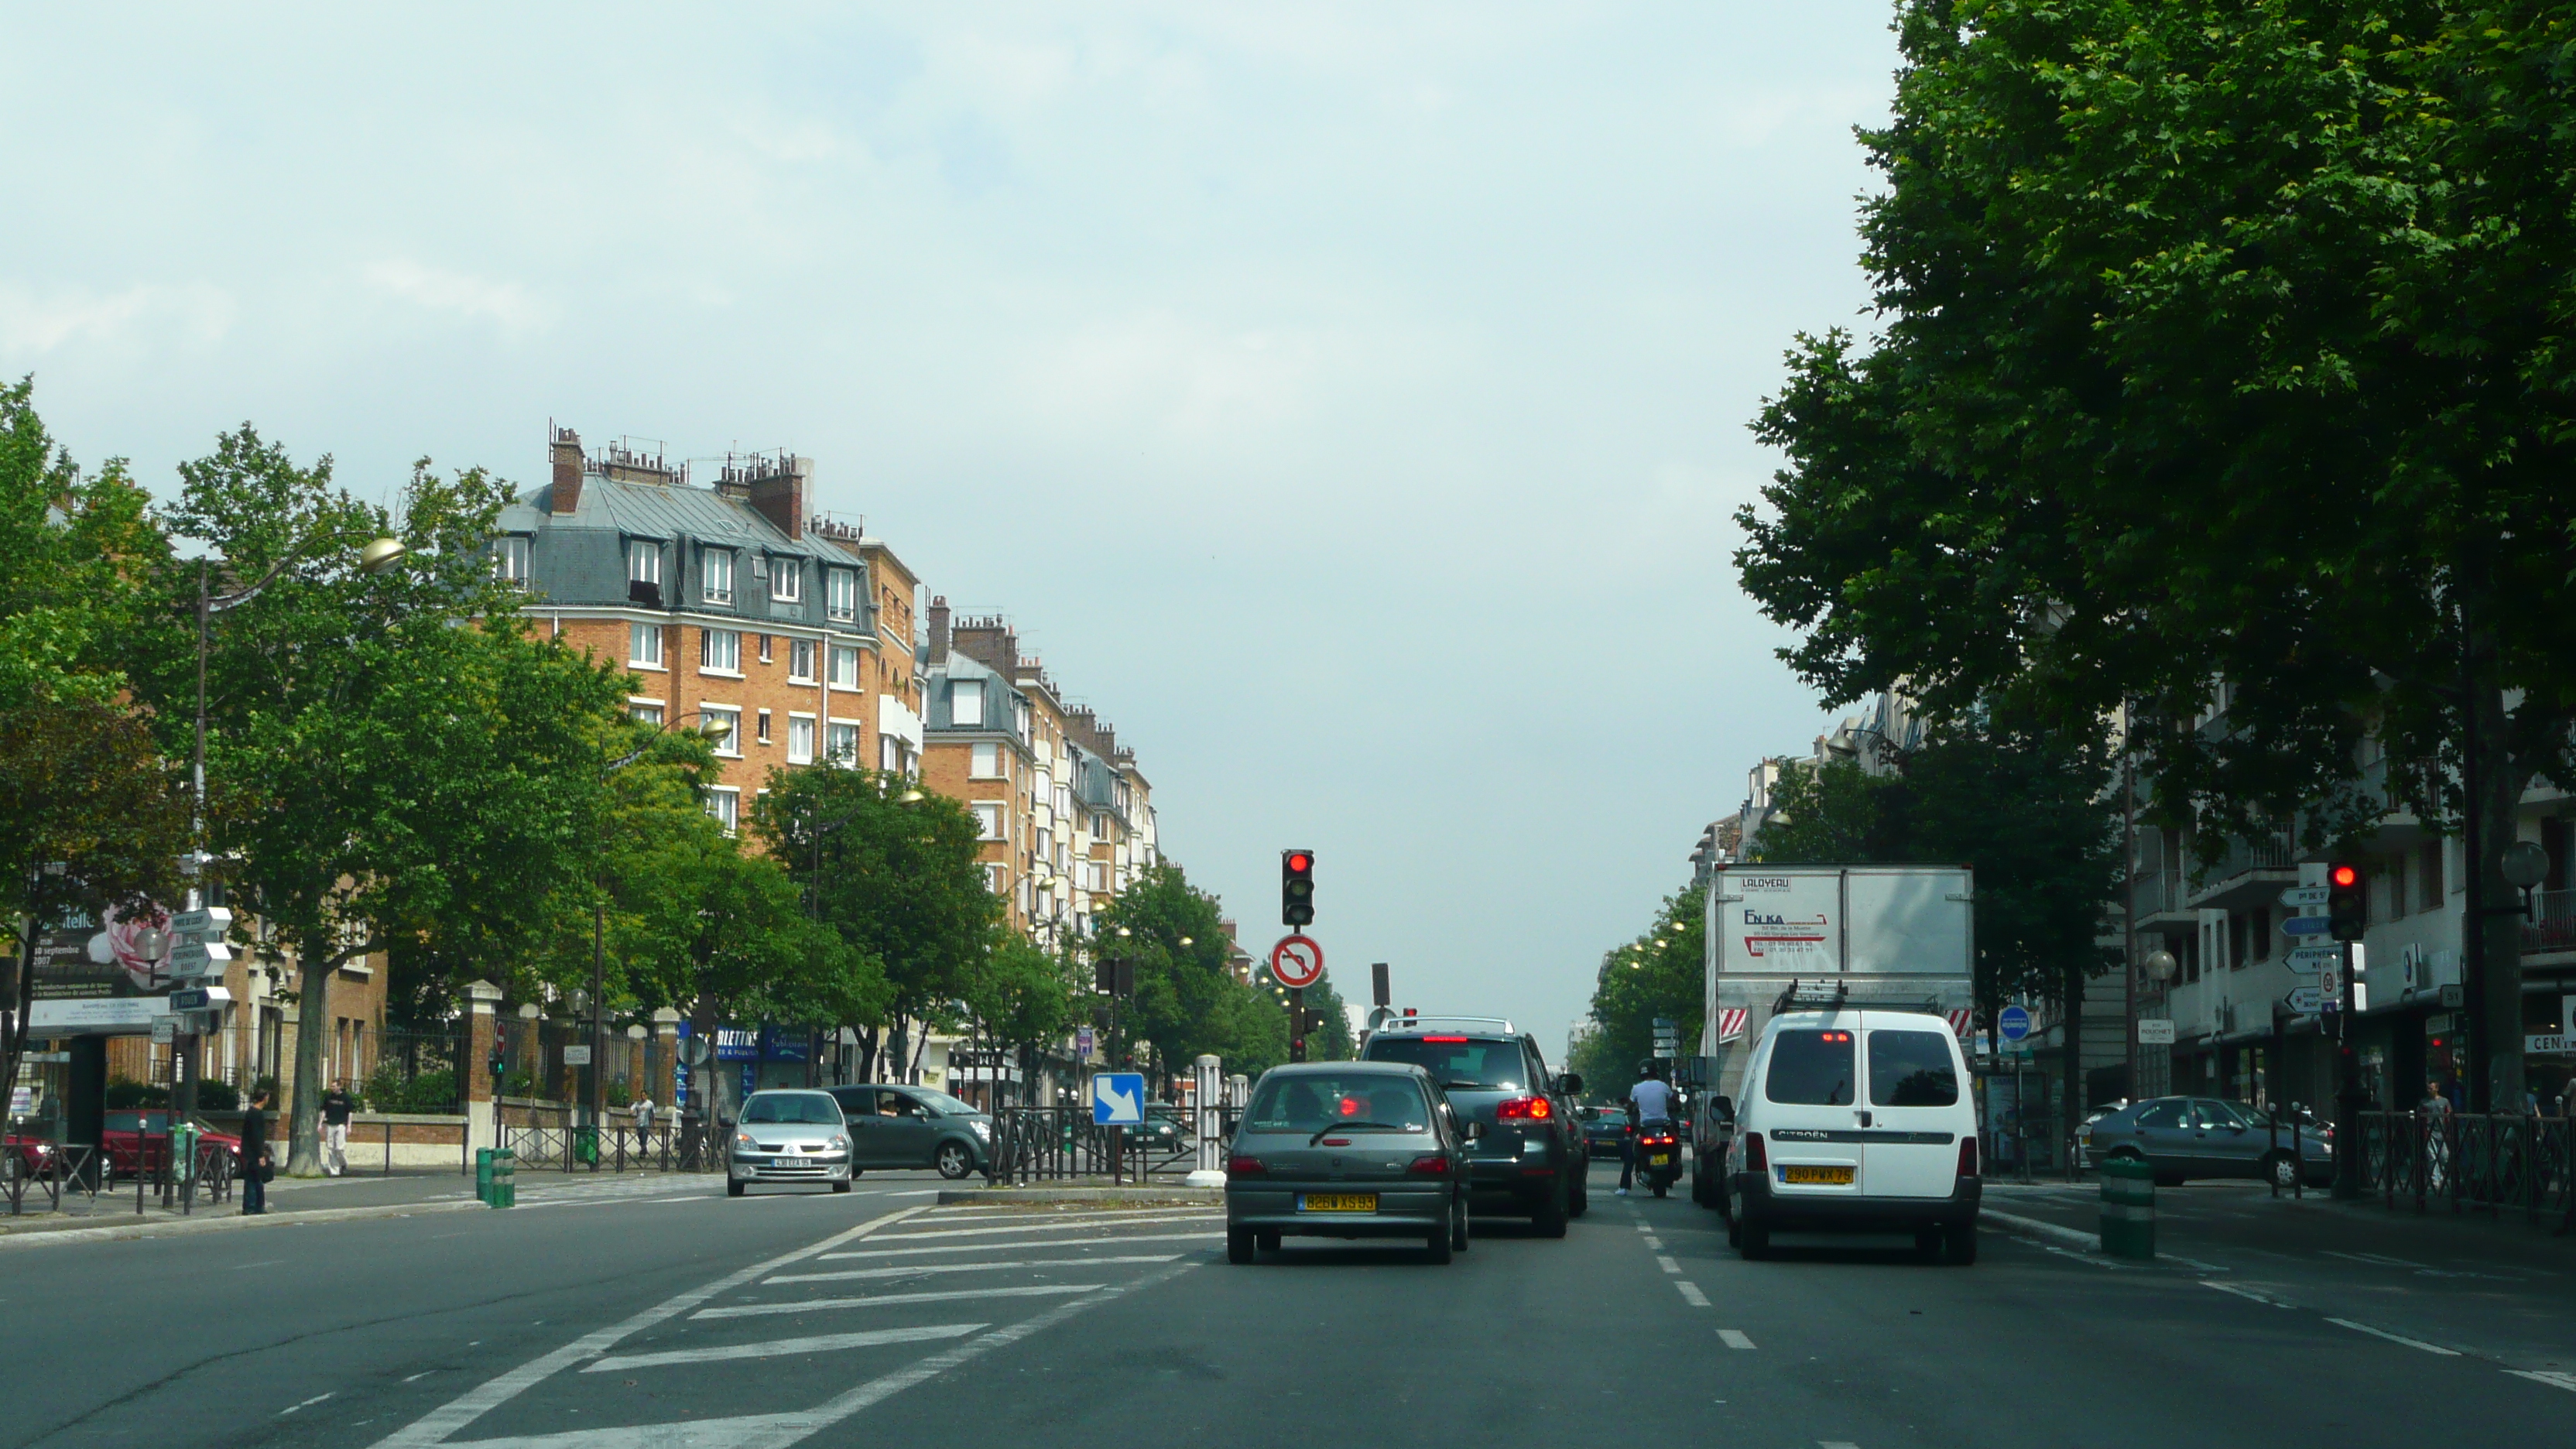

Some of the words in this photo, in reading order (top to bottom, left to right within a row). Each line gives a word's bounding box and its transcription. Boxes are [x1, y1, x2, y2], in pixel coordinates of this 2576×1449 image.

[1742, 879, 1789, 888] LALOYEAU
[44, 945, 80, 956] septembre
[33, 956, 51, 966] 2007
[2447, 992, 2459, 1001] 51
[1786, 1168, 1809, 1180] 290
[1835, 1169, 1851, 1181] 75
[1339, 1194, 1356, 1209] XS
[1358, 1194, 1374, 1209] 93
